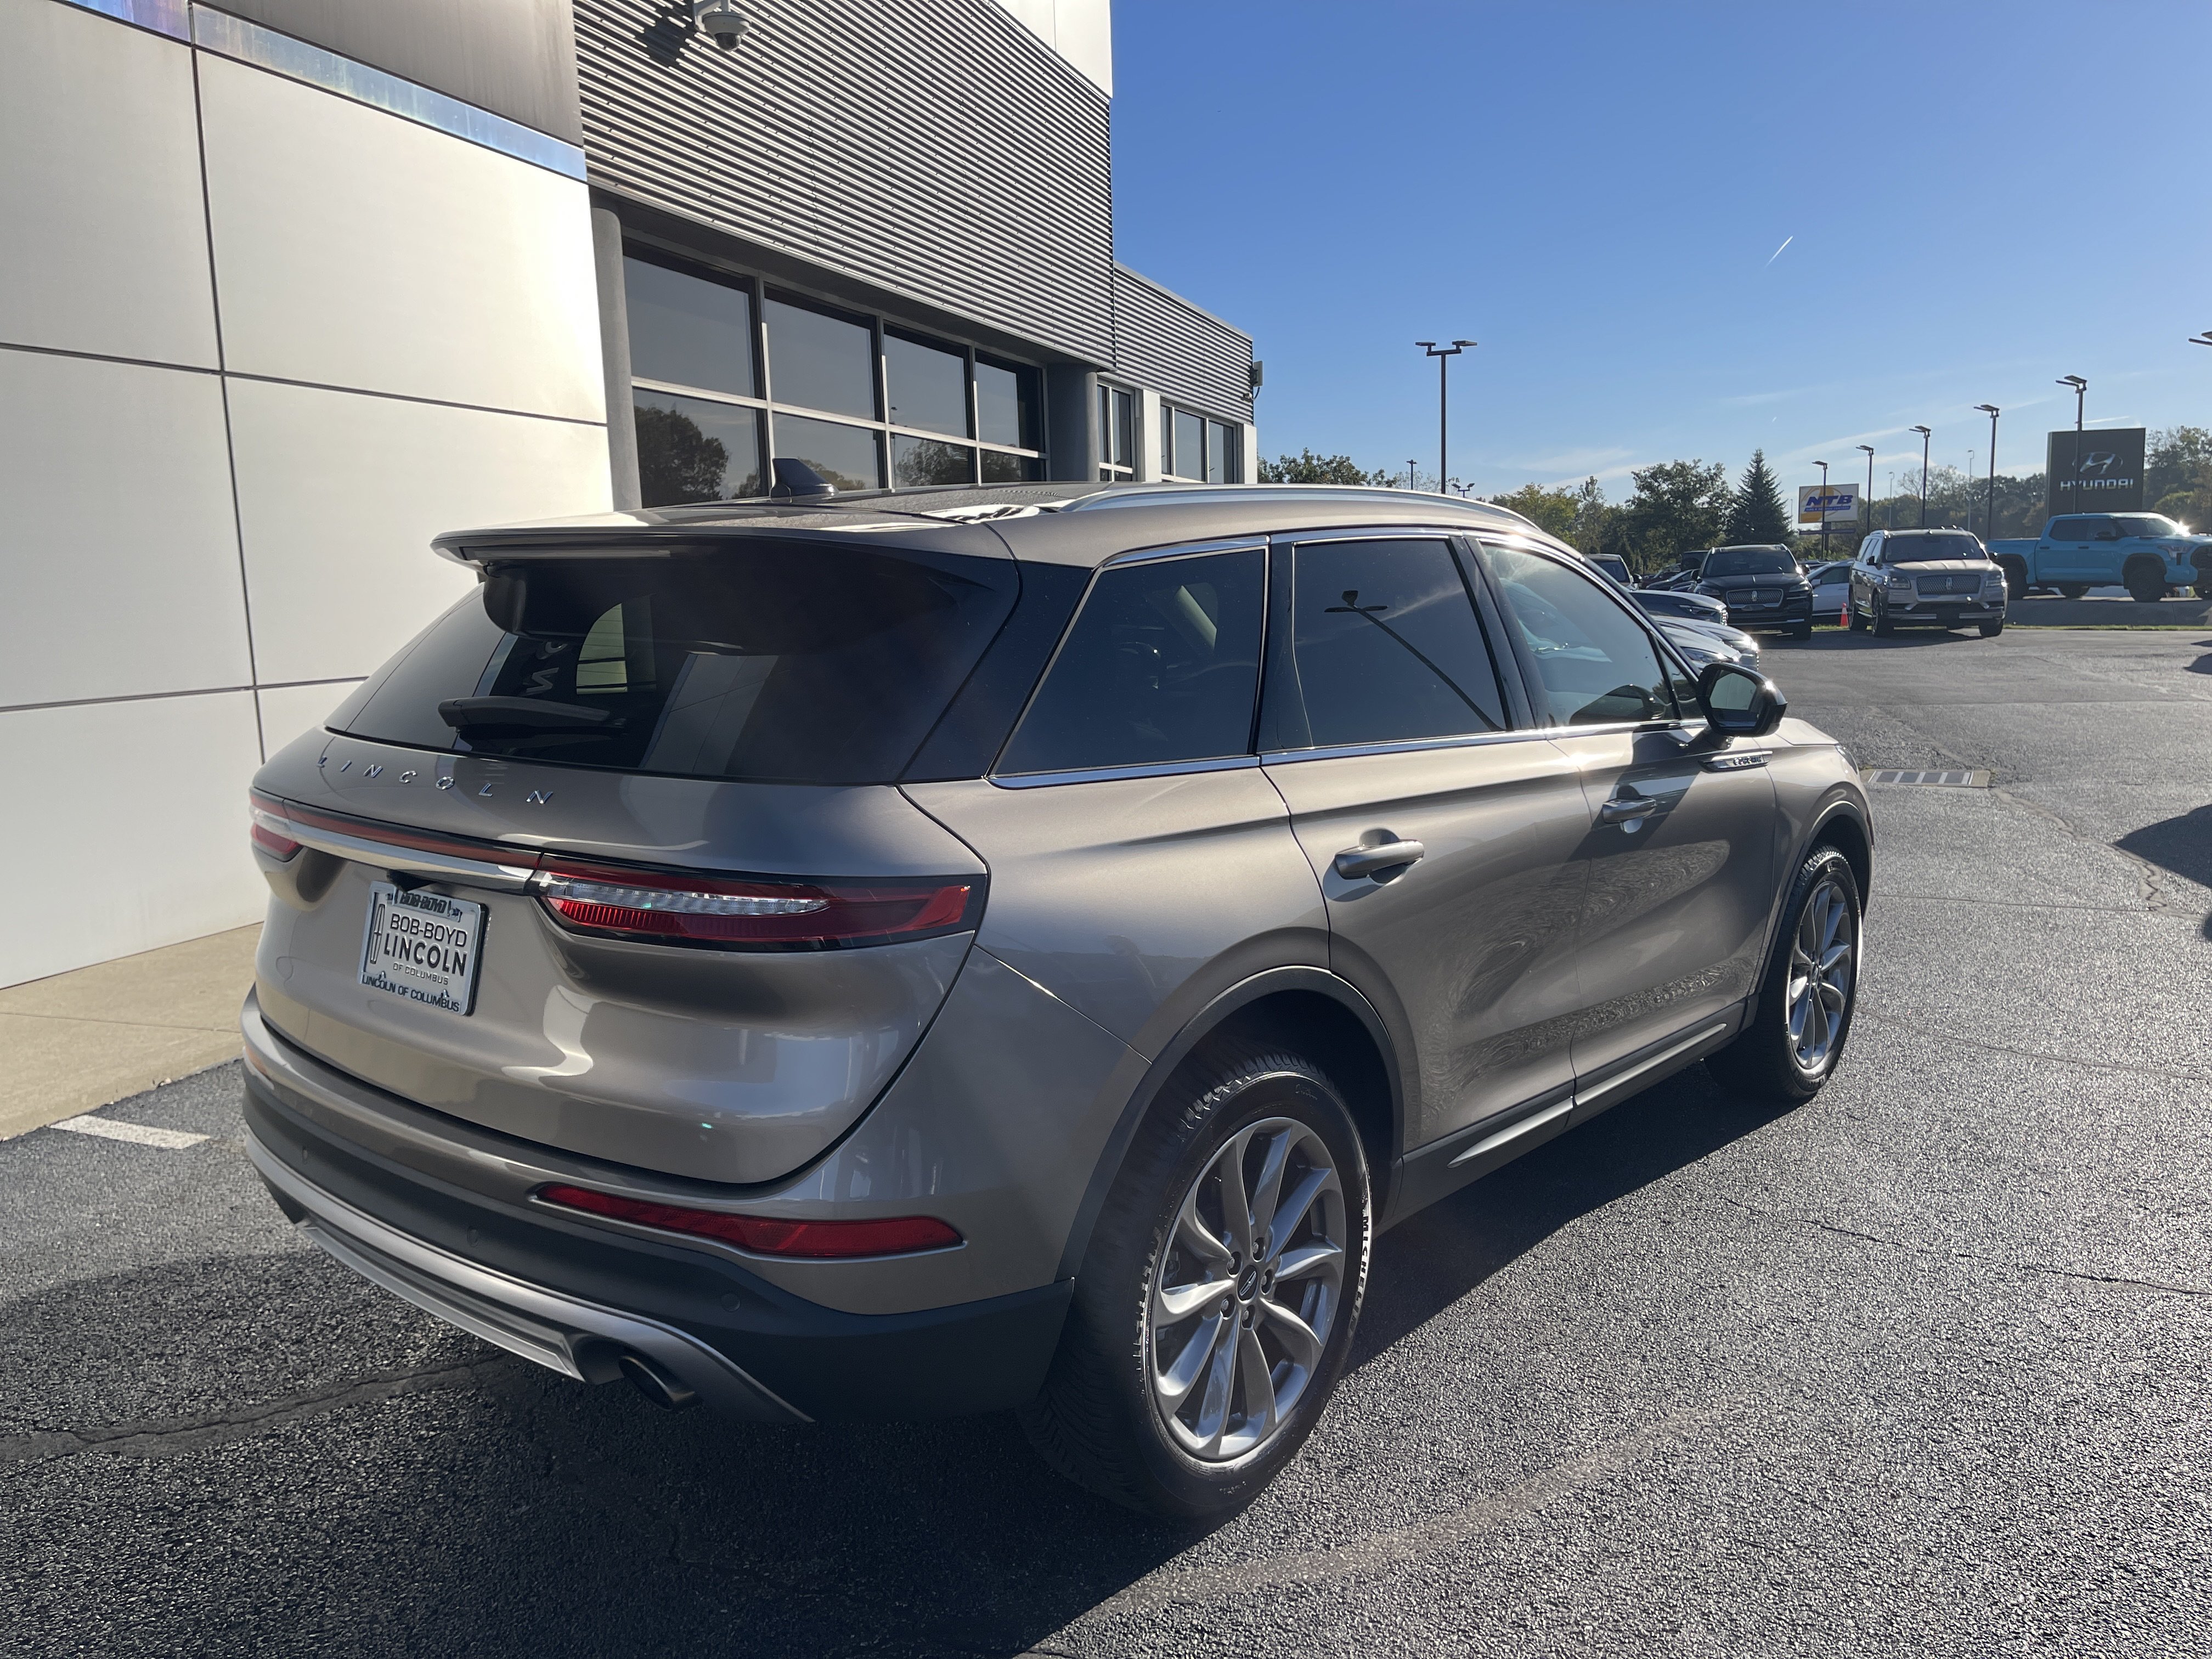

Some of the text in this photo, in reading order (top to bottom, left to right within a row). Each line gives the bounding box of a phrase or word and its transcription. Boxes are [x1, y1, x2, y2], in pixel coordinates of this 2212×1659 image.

[1805, 495, 1853, 506] NTB
[2060, 478, 2134, 492] HYUNDAI
[317, 755, 554, 804] LINCOLN
[390, 913, 467, 947] BOB-BOYD
[383, 933, 467, 977] LINCOLN
[393, 963, 449, 985] OF COLUMBUS
[362, 974, 460, 1012] LINCOLN OF COLUMBUS
[1348, 1216, 1369, 1334] MICHELIN
